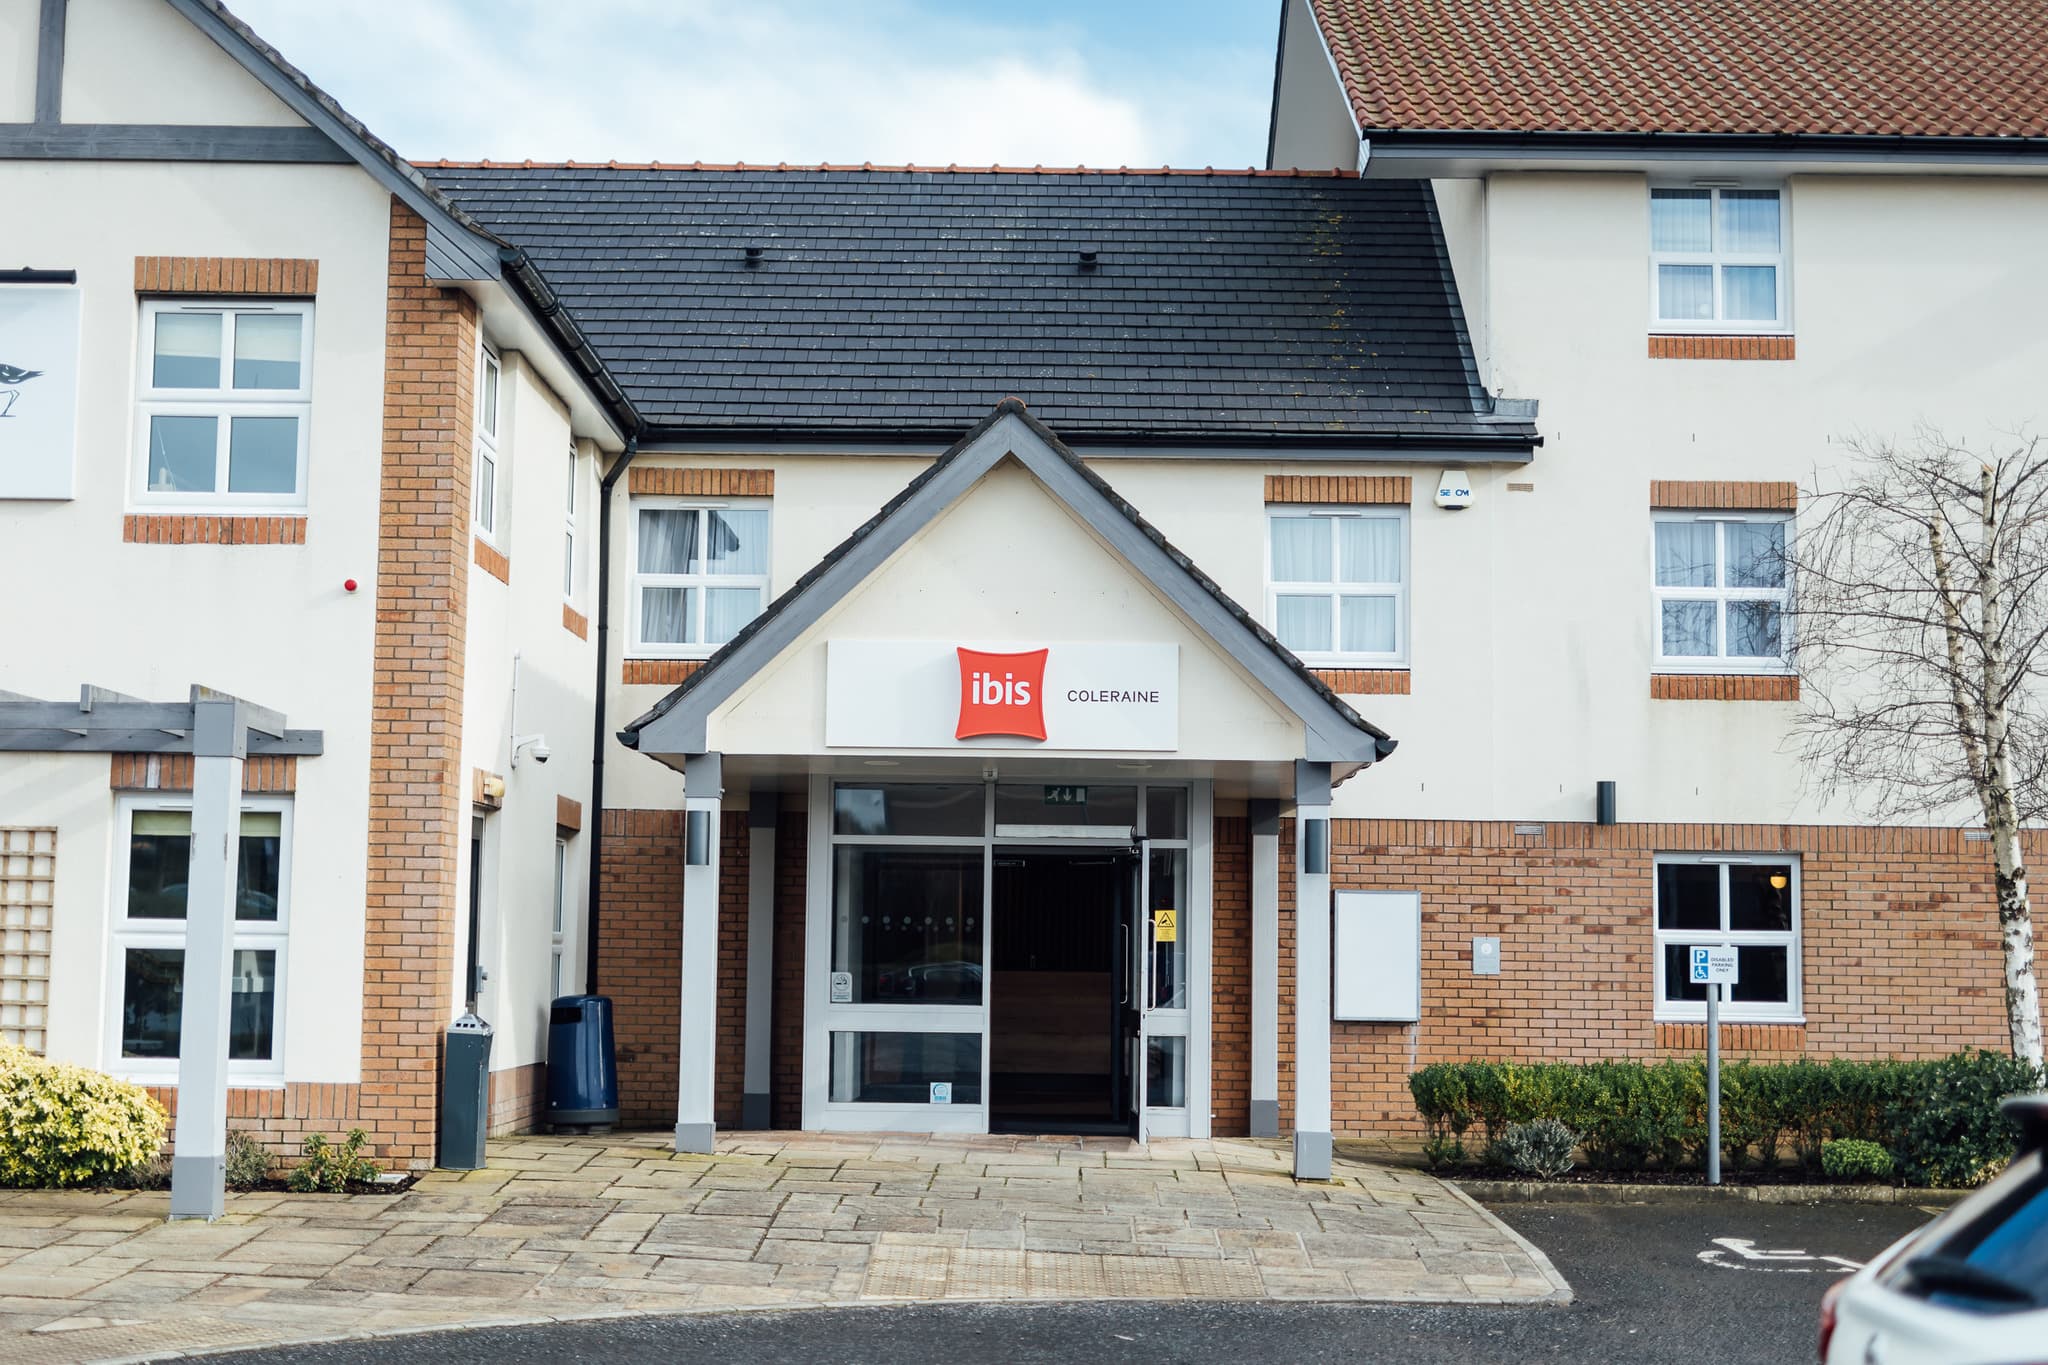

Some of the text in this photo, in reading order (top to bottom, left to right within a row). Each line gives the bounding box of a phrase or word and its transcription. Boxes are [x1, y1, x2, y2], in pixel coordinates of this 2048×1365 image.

[1440, 489, 1470, 497] SEOM
[972, 672, 1031, 706] ibis
[1067, 690, 1160, 703] COLERAINE
[1696, 950, 1706, 963] P
